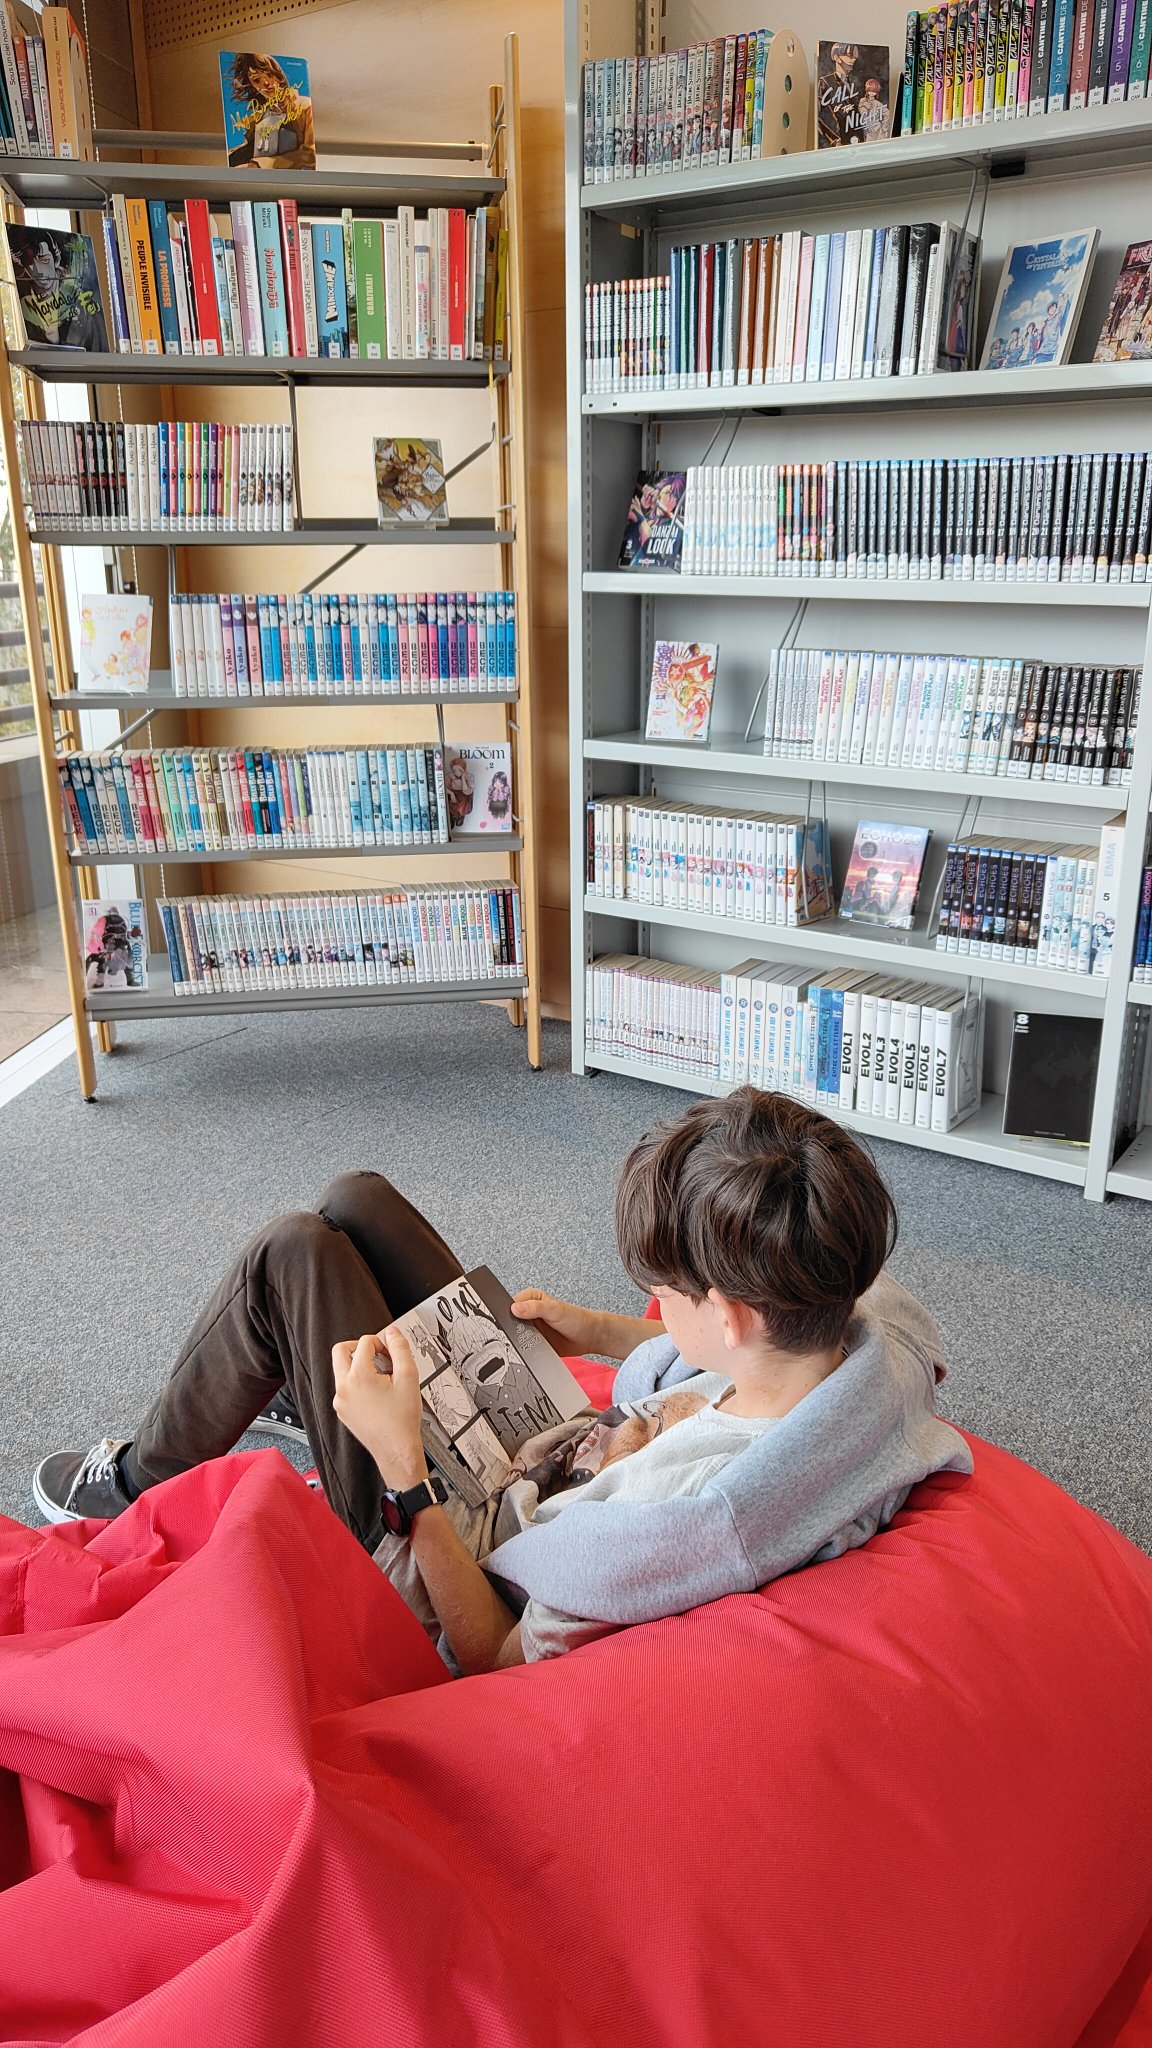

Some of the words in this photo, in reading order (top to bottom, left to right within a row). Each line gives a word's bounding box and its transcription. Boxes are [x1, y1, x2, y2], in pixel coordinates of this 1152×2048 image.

[1041, 9, 1047, 19] DE
[1060, 5, 1067, 15] DE
[1081, 1, 1088, 11] DE
[989, 16, 997, 35] NIGHT
[1012, 10, 1020, 29] NIGHT
[1024, 6, 1032, 26] NIGHT
[1118, 3, 1127, 42] CANTINE
[0, 11, 10, 43] nouveau
[1057, 16, 1066, 55] CANTINE
[1078, 12, 1087, 50] CANTINE
[1098, 8, 1107, 46] CANTINE
[3, 43, 12, 56] ciel
[1038, 20, 1047, 61] CANTINE
[1117, 46, 1123, 54] LA
[7, 57, 14, 68] un
[1057, 56, 1063, 65] LA
[1078, 52, 1083, 61] LA
[1097, 49, 1103, 58] LA
[1096, 66, 1101, 75] 4
[1116, 62, 1121, 71] 5
[1136, 59, 1142, 68] 6
[1056, 74, 1061, 82] 2
[1076, 70, 1081, 78] 3
[20, 76, 30, 99] ADIEU
[821, 83, 859, 106] CALL
[230, 111, 250, 135] My
[247, 81, 303, 122] Broken
[833, 104, 842, 112] OF
[845, 104, 887, 133] NIGHT
[136, 240, 147, 270] PEUPLE
[158, 250, 166, 261] LA
[302, 252, 309, 261] 30
[125, 272, 134, 297] HOKUSAI
[140, 272, 152, 310] INVISIBLE
[160, 264, 171, 308] PROMESSE
[322, 260, 338, 322] MINDGAME
[365, 277, 375, 315] CHARIVARI
[24, 289, 77, 327] Mandala
[1139, 526, 1147, 534] 29
[626, 541, 632, 549] 3
[647, 539, 676, 554] LOOK
[238, 646, 246, 674] Ayako
[371, 643, 379, 674] BECK
[460, 749, 505, 759] BLOOM
[1105, 843, 1116, 877] EMMA
[966, 862, 976, 896] ECHOES
[1010, 867, 1020, 903] ECHOES
[1034, 870, 1044, 906] ECHOES
[1103, 892, 1110, 901] 5
[89, 907, 97, 916] 31
[1017, 1014, 1029, 1025] 8
